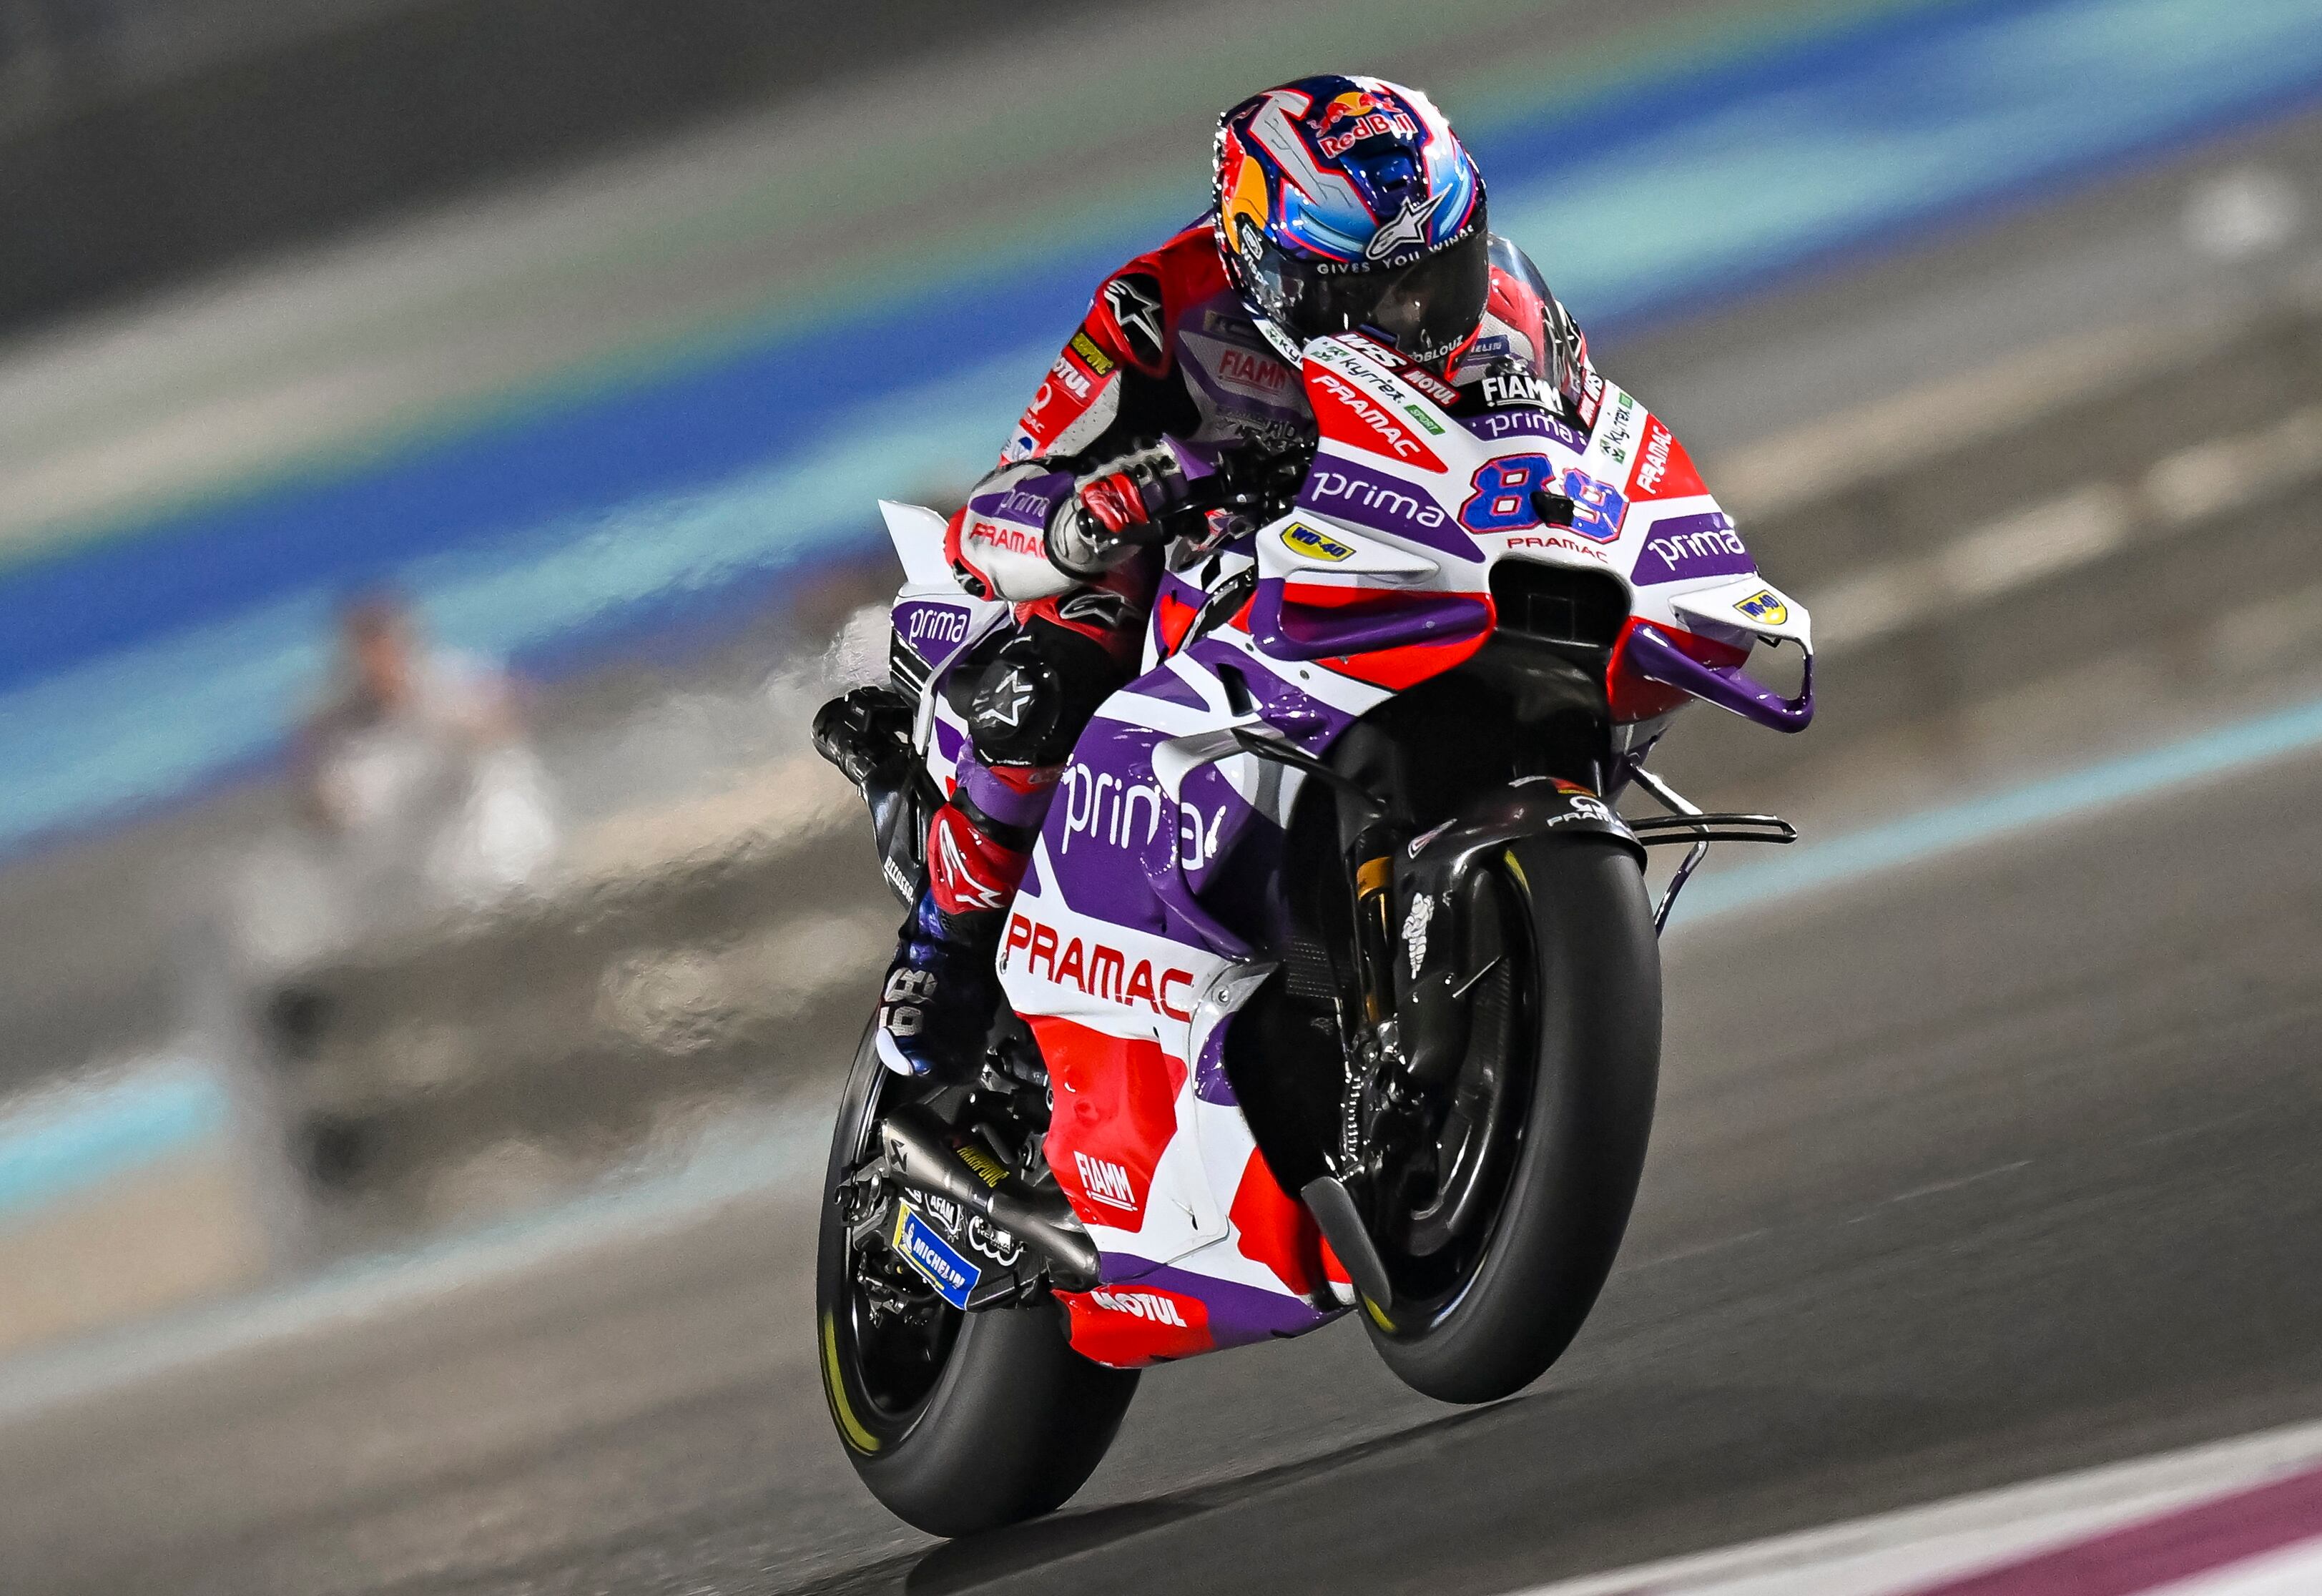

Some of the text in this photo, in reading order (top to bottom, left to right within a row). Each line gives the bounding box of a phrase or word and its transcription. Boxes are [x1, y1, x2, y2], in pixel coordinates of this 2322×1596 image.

[1317, 113, 1418, 159] Red Bull
[1317, 262, 1371, 275] GIVES
[1382, 251, 1421, 269] YOU
[1336, 334, 1407, 367] WRS
[1404, 370, 1456, 404] MOTUL
[1482, 375, 1565, 415] FIAMM
[1312, 375, 1421, 456] PRAMAC
[1485, 409, 1573, 443] prima
[1636, 425, 1673, 494] PRAMAC
[1313, 471, 1445, 528] prima
[1457, 453, 1629, 543] 89
[1294, 526, 1347, 558] WD-40
[1507, 536, 1608, 563] PRAMAC
[1648, 528, 1746, 571] prima
[1741, 593, 1779, 617] WD-40
[909, 609, 968, 646] prima
[1006, 912, 1195, 1023] PRAMAC
[1073, 1151, 1135, 1203] FIAMM
[914, 1238, 965, 1289] MICHELIN
[1091, 1290, 1187, 1328] MOTUL
